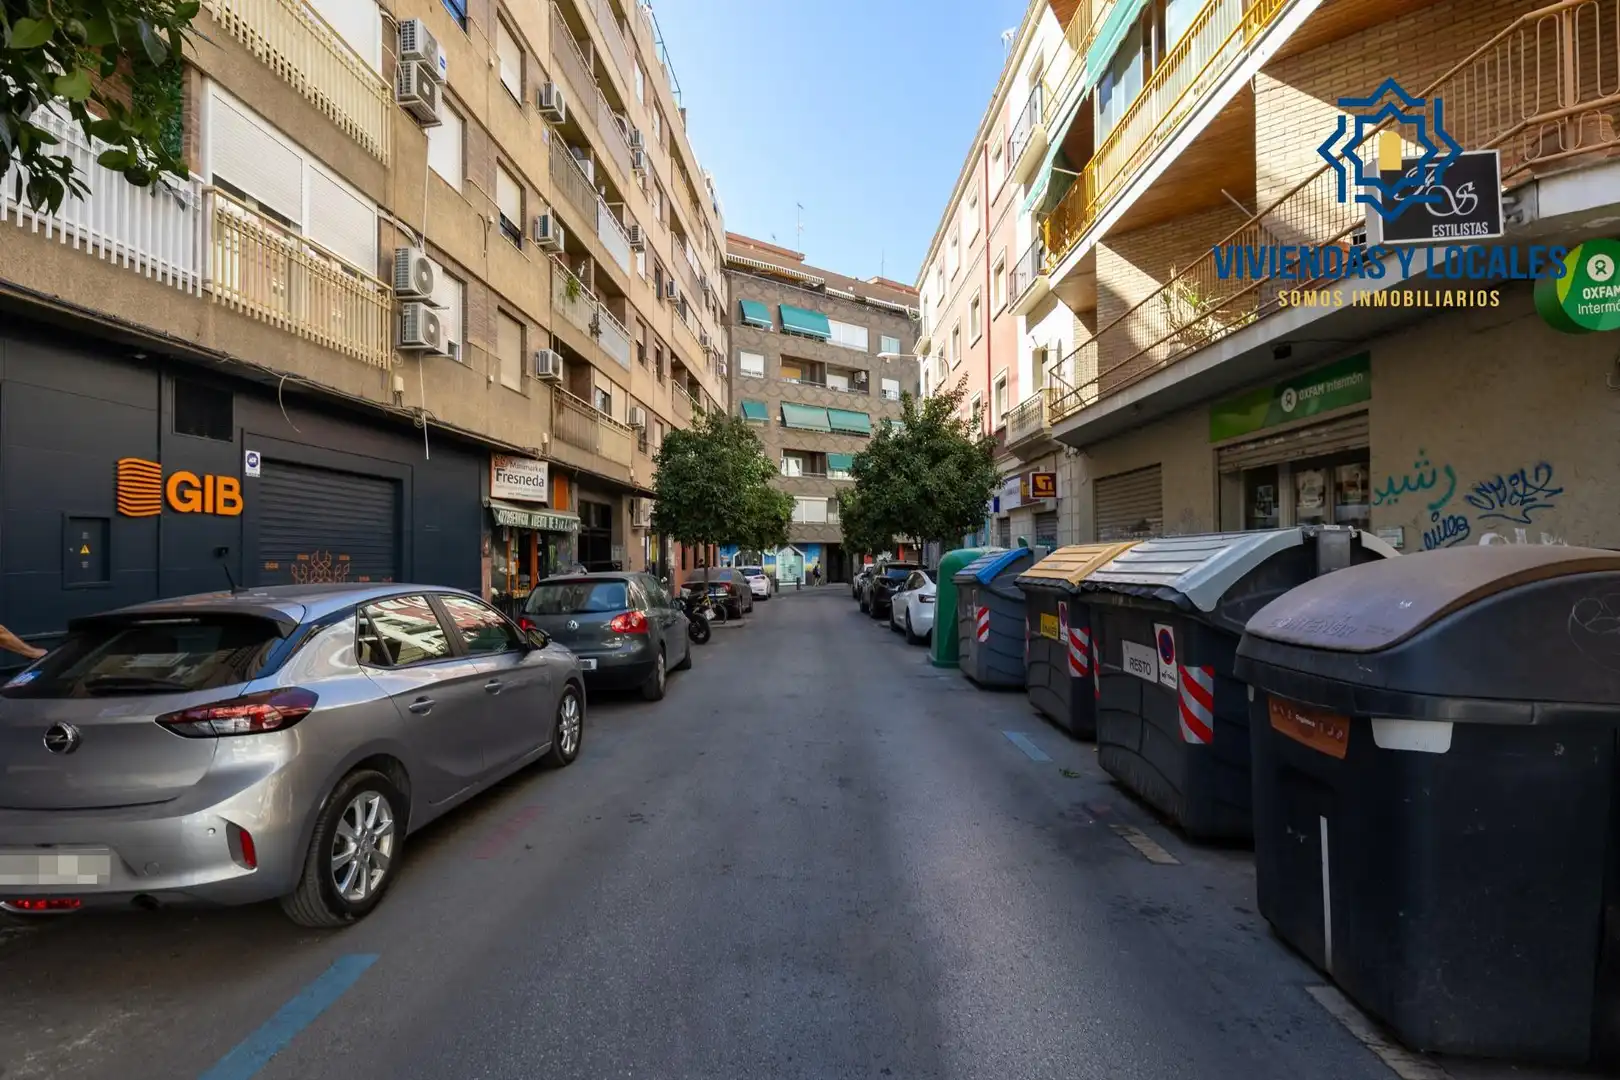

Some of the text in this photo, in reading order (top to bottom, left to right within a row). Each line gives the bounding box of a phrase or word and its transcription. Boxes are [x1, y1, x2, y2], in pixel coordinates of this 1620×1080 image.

[1432, 222, 1489, 237] ESTILISTAS
[1582, 285, 1620, 300] OXFAM
[1299, 382, 1325, 400] OXFAM
[509, 460, 544, 473] Minimarket
[495, 468, 545, 487] Fresneda
[166, 470, 243, 516] GIB
[1129, 657, 1152, 676] RESTO
